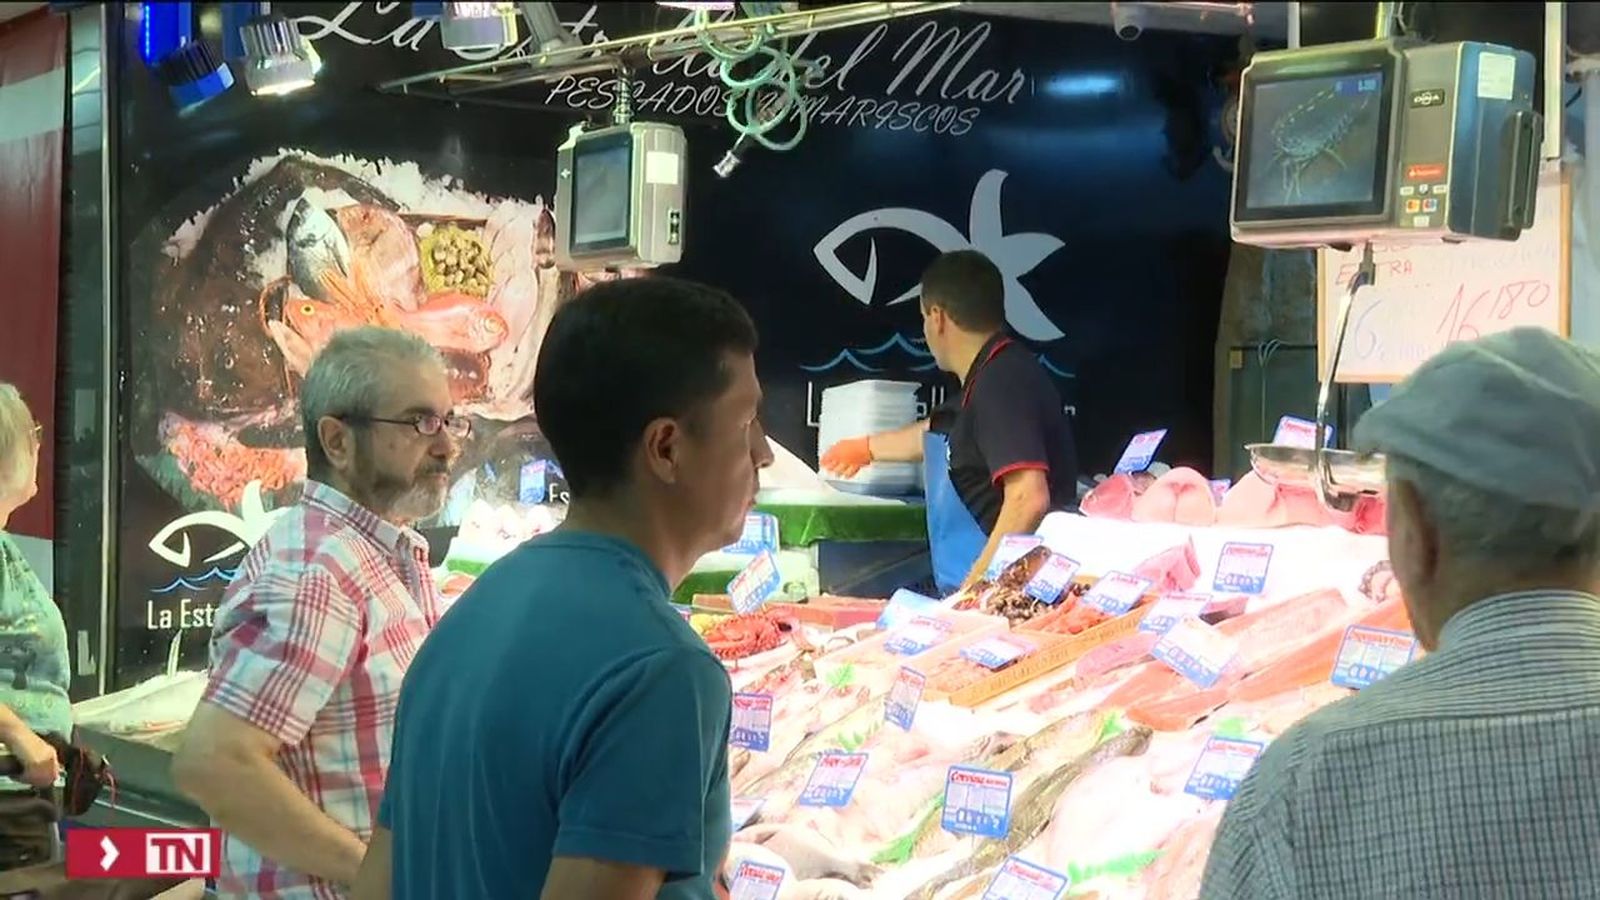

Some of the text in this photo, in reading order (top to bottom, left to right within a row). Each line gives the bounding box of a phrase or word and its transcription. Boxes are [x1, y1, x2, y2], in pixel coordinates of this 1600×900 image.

[892, 20, 1027, 104] Mar
[147, 598, 221, 629] La Est
